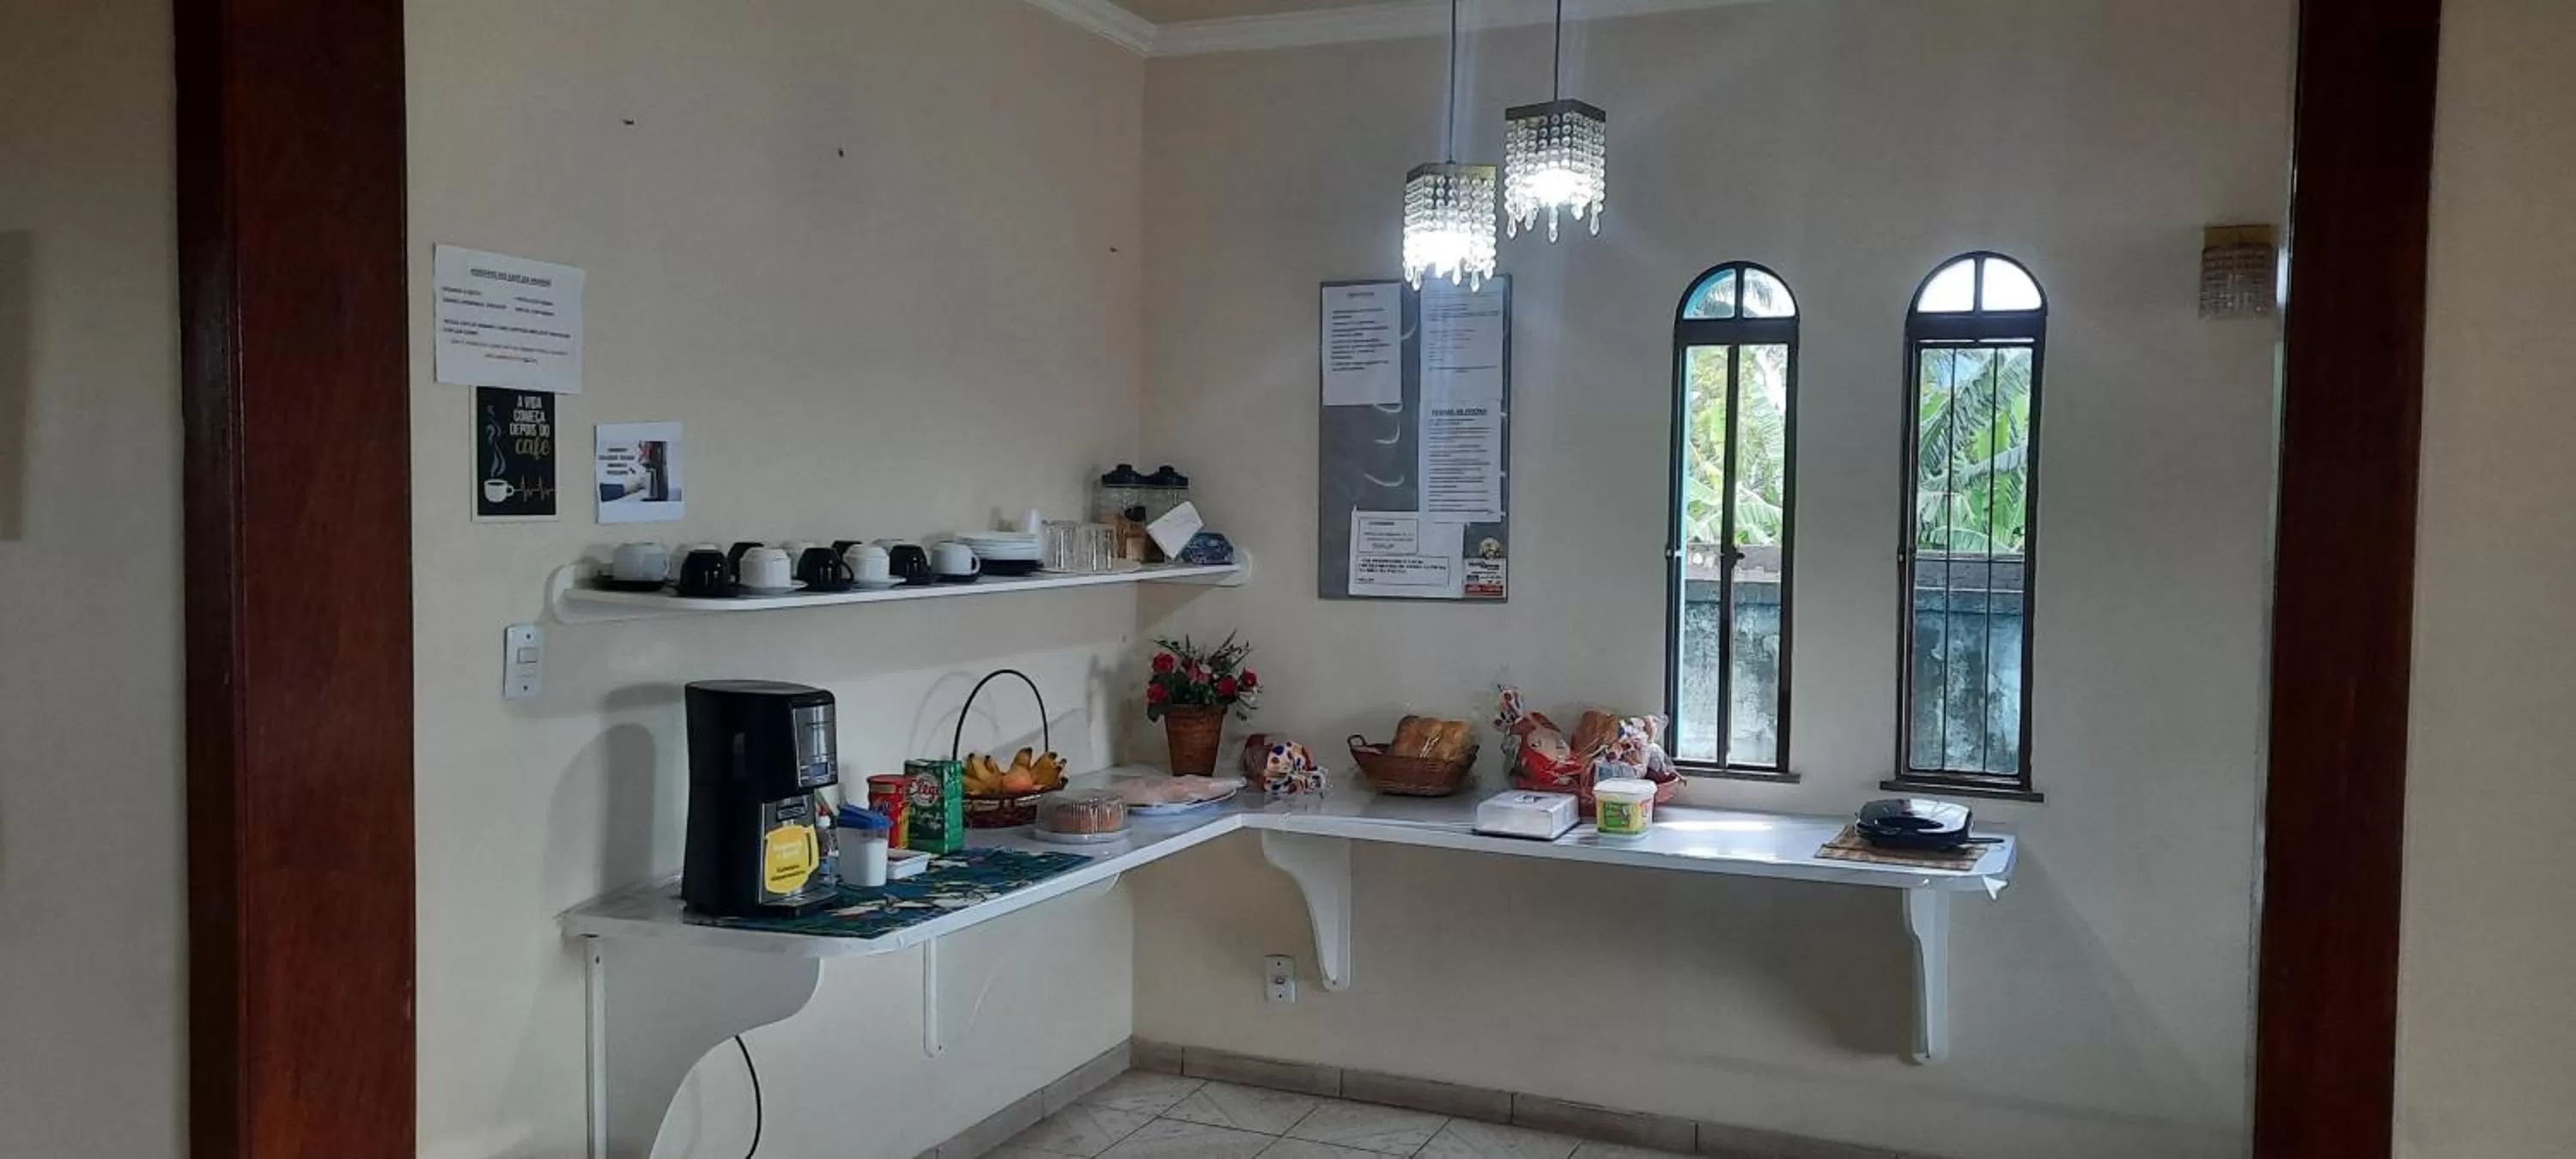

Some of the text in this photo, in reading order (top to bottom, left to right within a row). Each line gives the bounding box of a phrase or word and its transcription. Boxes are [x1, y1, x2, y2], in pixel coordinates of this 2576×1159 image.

[517, 394, 543, 409] A VIDA
[513, 409, 546, 423] COMEÇA
[509, 422, 550, 438] DEPOIS DO
